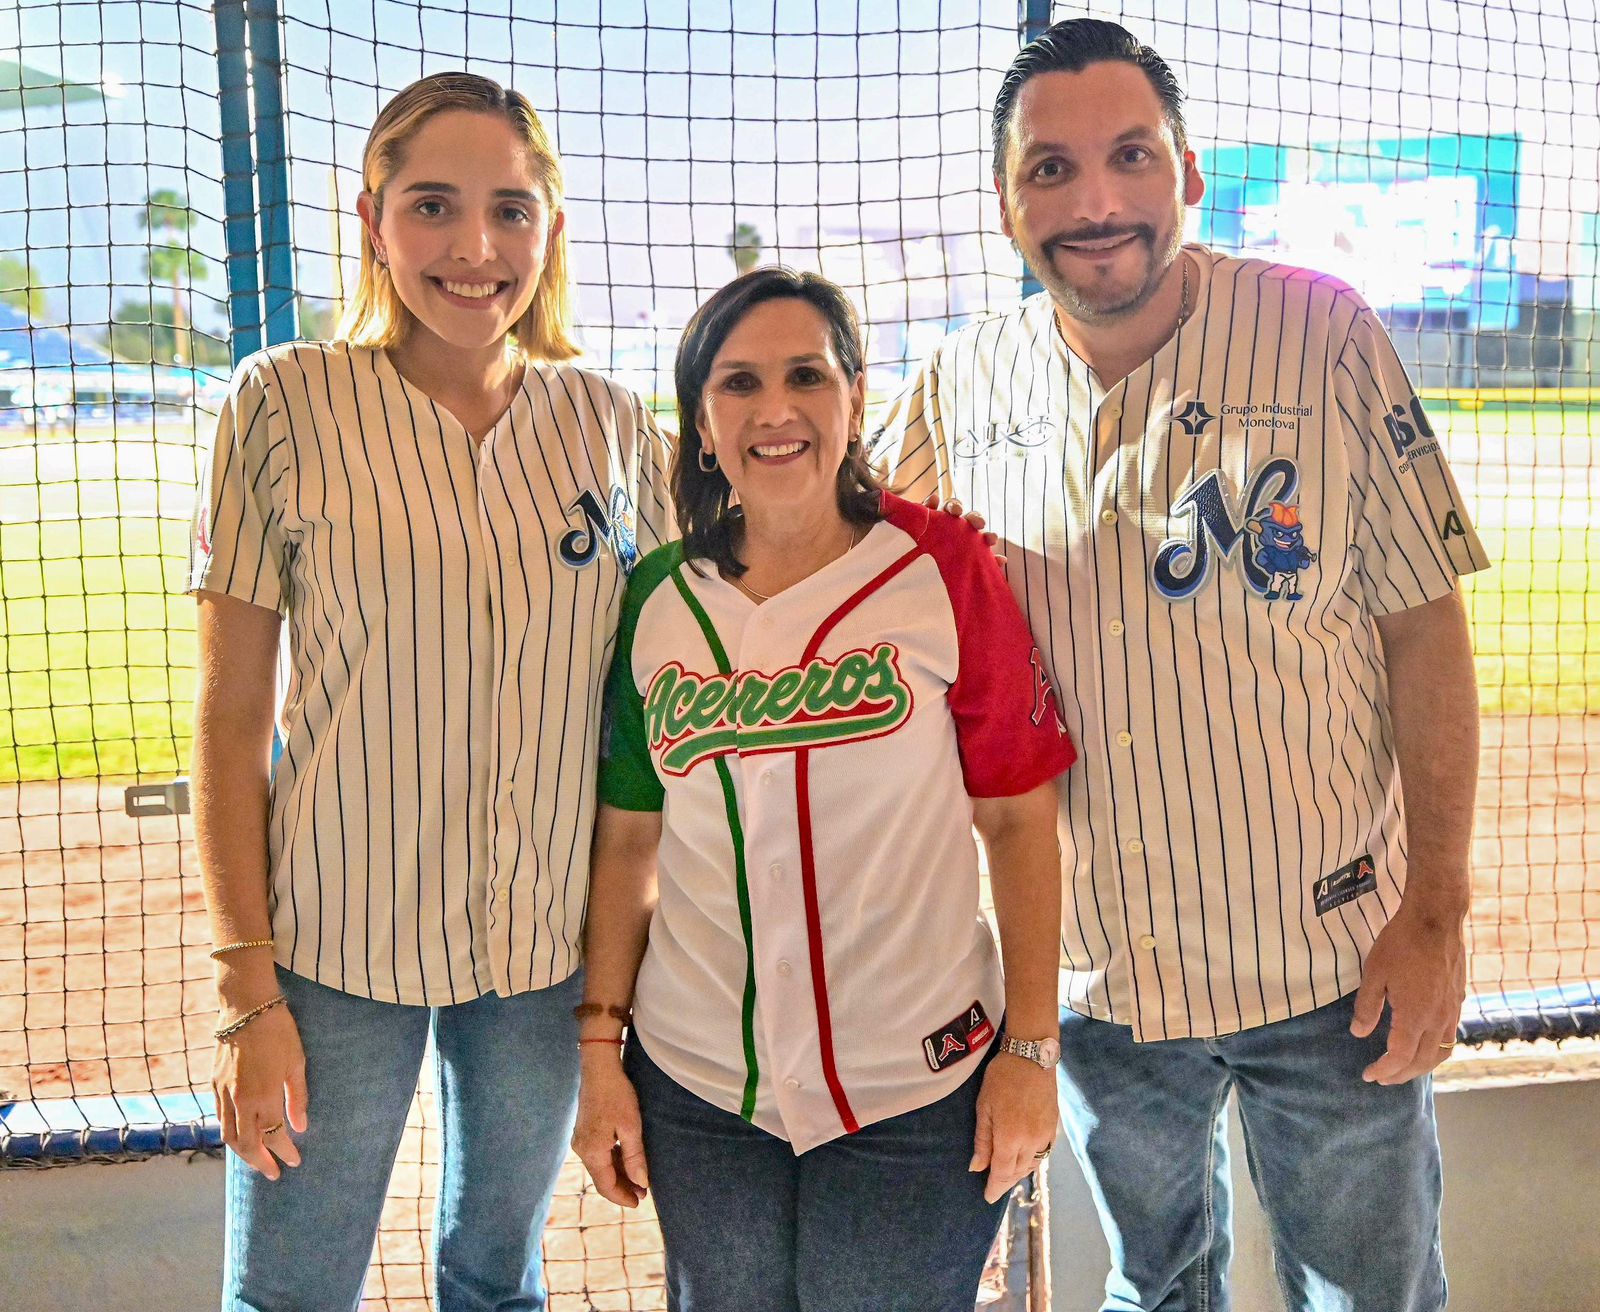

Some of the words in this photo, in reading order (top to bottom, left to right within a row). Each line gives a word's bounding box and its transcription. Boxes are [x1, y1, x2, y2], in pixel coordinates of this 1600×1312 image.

[1220, 403, 1258, 418] Grupo
[1261, 403, 1313, 417] Industrial
[1237, 417, 1295, 430] Monclova
[645, 643, 911, 750] Acereros
